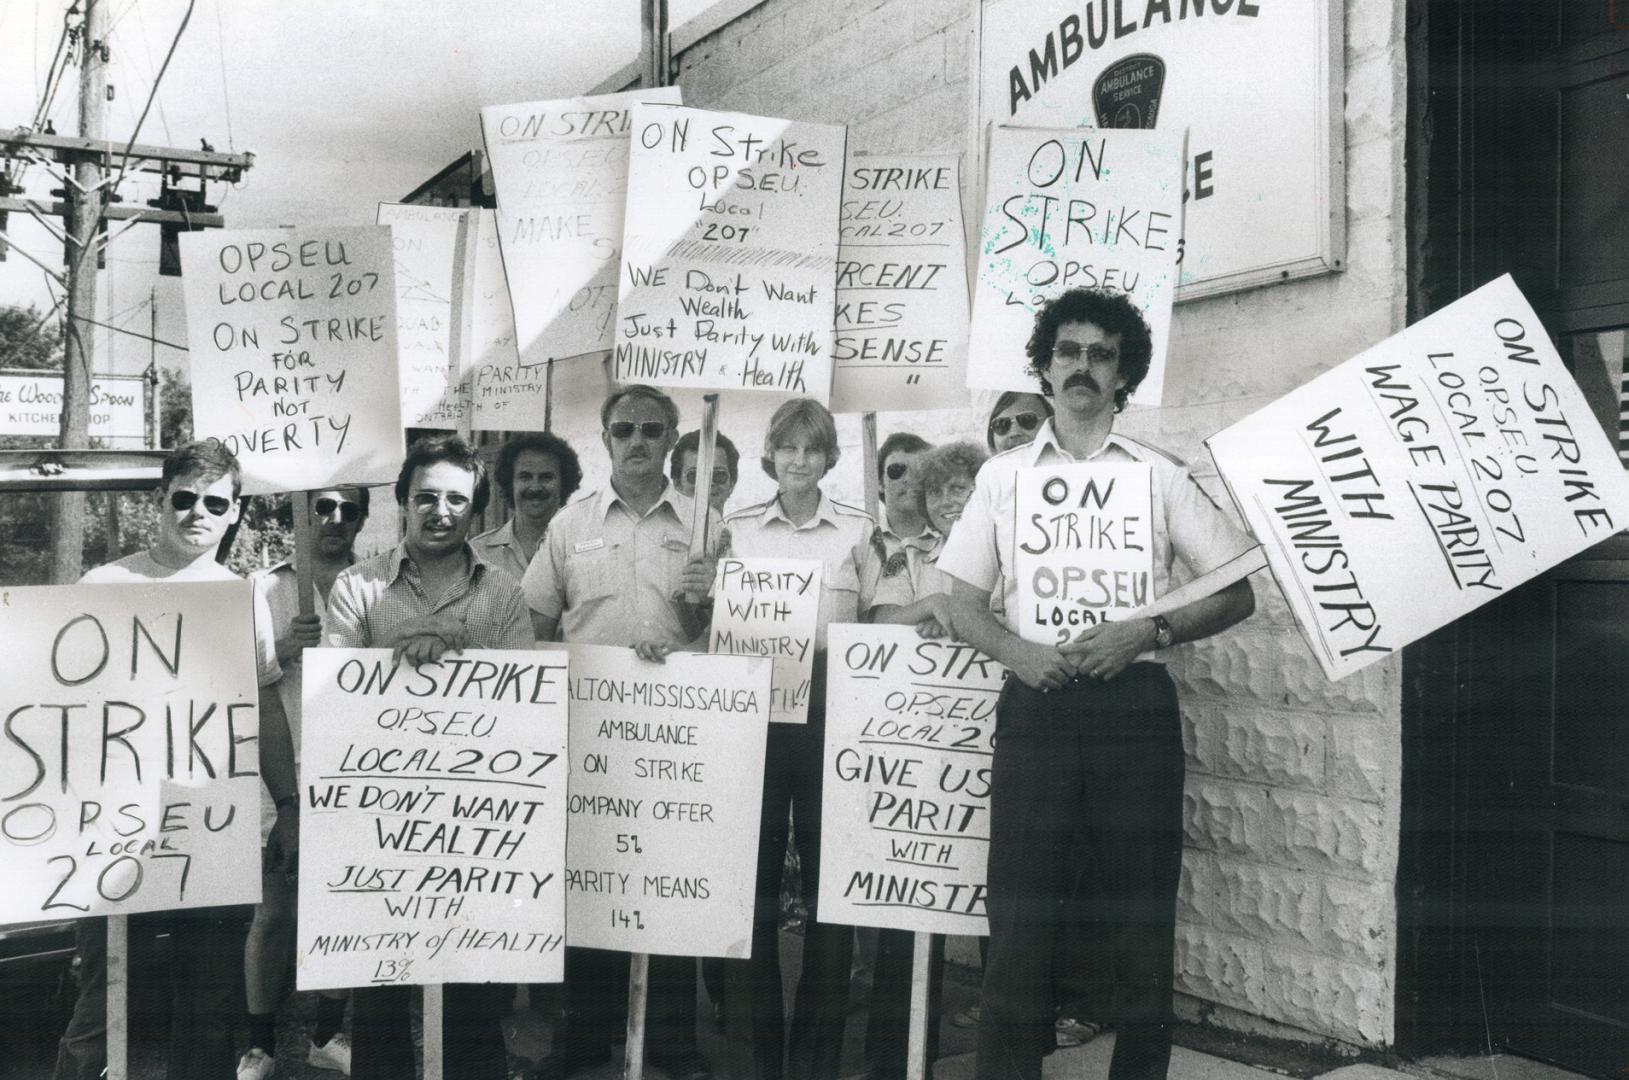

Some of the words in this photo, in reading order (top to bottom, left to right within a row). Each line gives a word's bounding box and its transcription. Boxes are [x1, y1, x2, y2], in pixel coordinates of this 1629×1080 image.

[1101, 65, 1155, 95] AMBULANCE
[1112, 84, 1143, 102] SERVICE
[500, 113, 546, 138] ON
[641, 118, 690, 152] ON
[710, 126, 827, 170] Strike
[851, 167, 951, 191] STRIKE
[1027, 138, 1106, 188] ON
[994, 194, 1173, 254] STRIKE
[219, 240, 353, 274] OPSEU
[219, 279, 315, 305] LOCAL
[328, 272, 380, 299] 207
[627, 262, 671, 288] WE
[686, 269, 750, 296] Don't
[762, 280, 818, 305] Want
[1026, 260, 1140, 292] OPSEU
[679, 296, 752, 321] Wealth
[213, 322, 260, 352] ON
[280, 315, 387, 345] STRIKE
[624, 313, 678, 339] Just
[694, 319, 765, 358] Parity
[772, 331, 822, 357] With
[830, 337, 948, 363] SENSE
[1494, 317, 1542, 367] ON
[272, 350, 316, 371] FOR
[477, 364, 543, 386] PARITY
[615, 342, 708, 381] MINISTRY
[234, 370, 347, 402] PARITY
[482, 383, 543, 398] MINISTRY
[1427, 352, 1487, 448] LOCAL
[8, 412, 60, 424] KITCHE
[273, 397, 311, 418] NOT
[1305, 407, 1395, 520] WITH
[1523, 380, 1615, 538] STRIKE
[1042, 477, 1116, 510] ON
[1365, 364, 1447, 467] WAGE
[1418, 480, 1503, 592] PARITY
[1019, 512, 1145, 555] STRIKE
[721, 560, 815, 596] PARITY
[1262, 478, 1393, 657] MINISTRY
[727, 597, 793, 622] WITH
[1036, 603, 1111, 627] LOCAL
[51, 612, 184, 687] ON
[715, 629, 811, 663] MINISTRY
[845, 642, 899, 673] ON
[336, 658, 399, 696] ON
[404, 659, 568, 704] STRIKE
[597, 719, 699, 746] AMBULANCE
[861, 717, 944, 742] LOCAL
[1, 699, 260, 801] STRIKE
[339, 744, 443, 773] LOCAL
[583, 753, 609, 775] ON
[634, 757, 705, 783] STRIKE
[836, 748, 923, 788] GIVE
[938, 764, 992, 799] US
[308, 784, 352, 809] WE
[358, 783, 446, 814] DON'T
[451, 794, 545, 826] WANT
[567, 794, 644, 819] OMPANY
[652, 800, 715, 824] OFFER
[2, 801, 236, 846] OPSEU
[375, 816, 527, 861] WEALTH
[86, 837, 180, 857] LOCAL
[615, 833, 643, 854] 5%
[890, 838, 953, 863] WITH
[41, 854, 191, 912] 207
[327, 864, 415, 891] JUST
[414, 866, 555, 900] PARITY
[565, 868, 630, 895] PARITY
[643, 874, 711, 900] MEANS
[384, 895, 465, 920] WITH
[611, 908, 645, 931] 14%
[308, 930, 420, 956] MINISTRY
[425, 925, 459, 960] of
[456, 928, 564, 954] HEALTH
[373, 958, 416, 984] 13%
